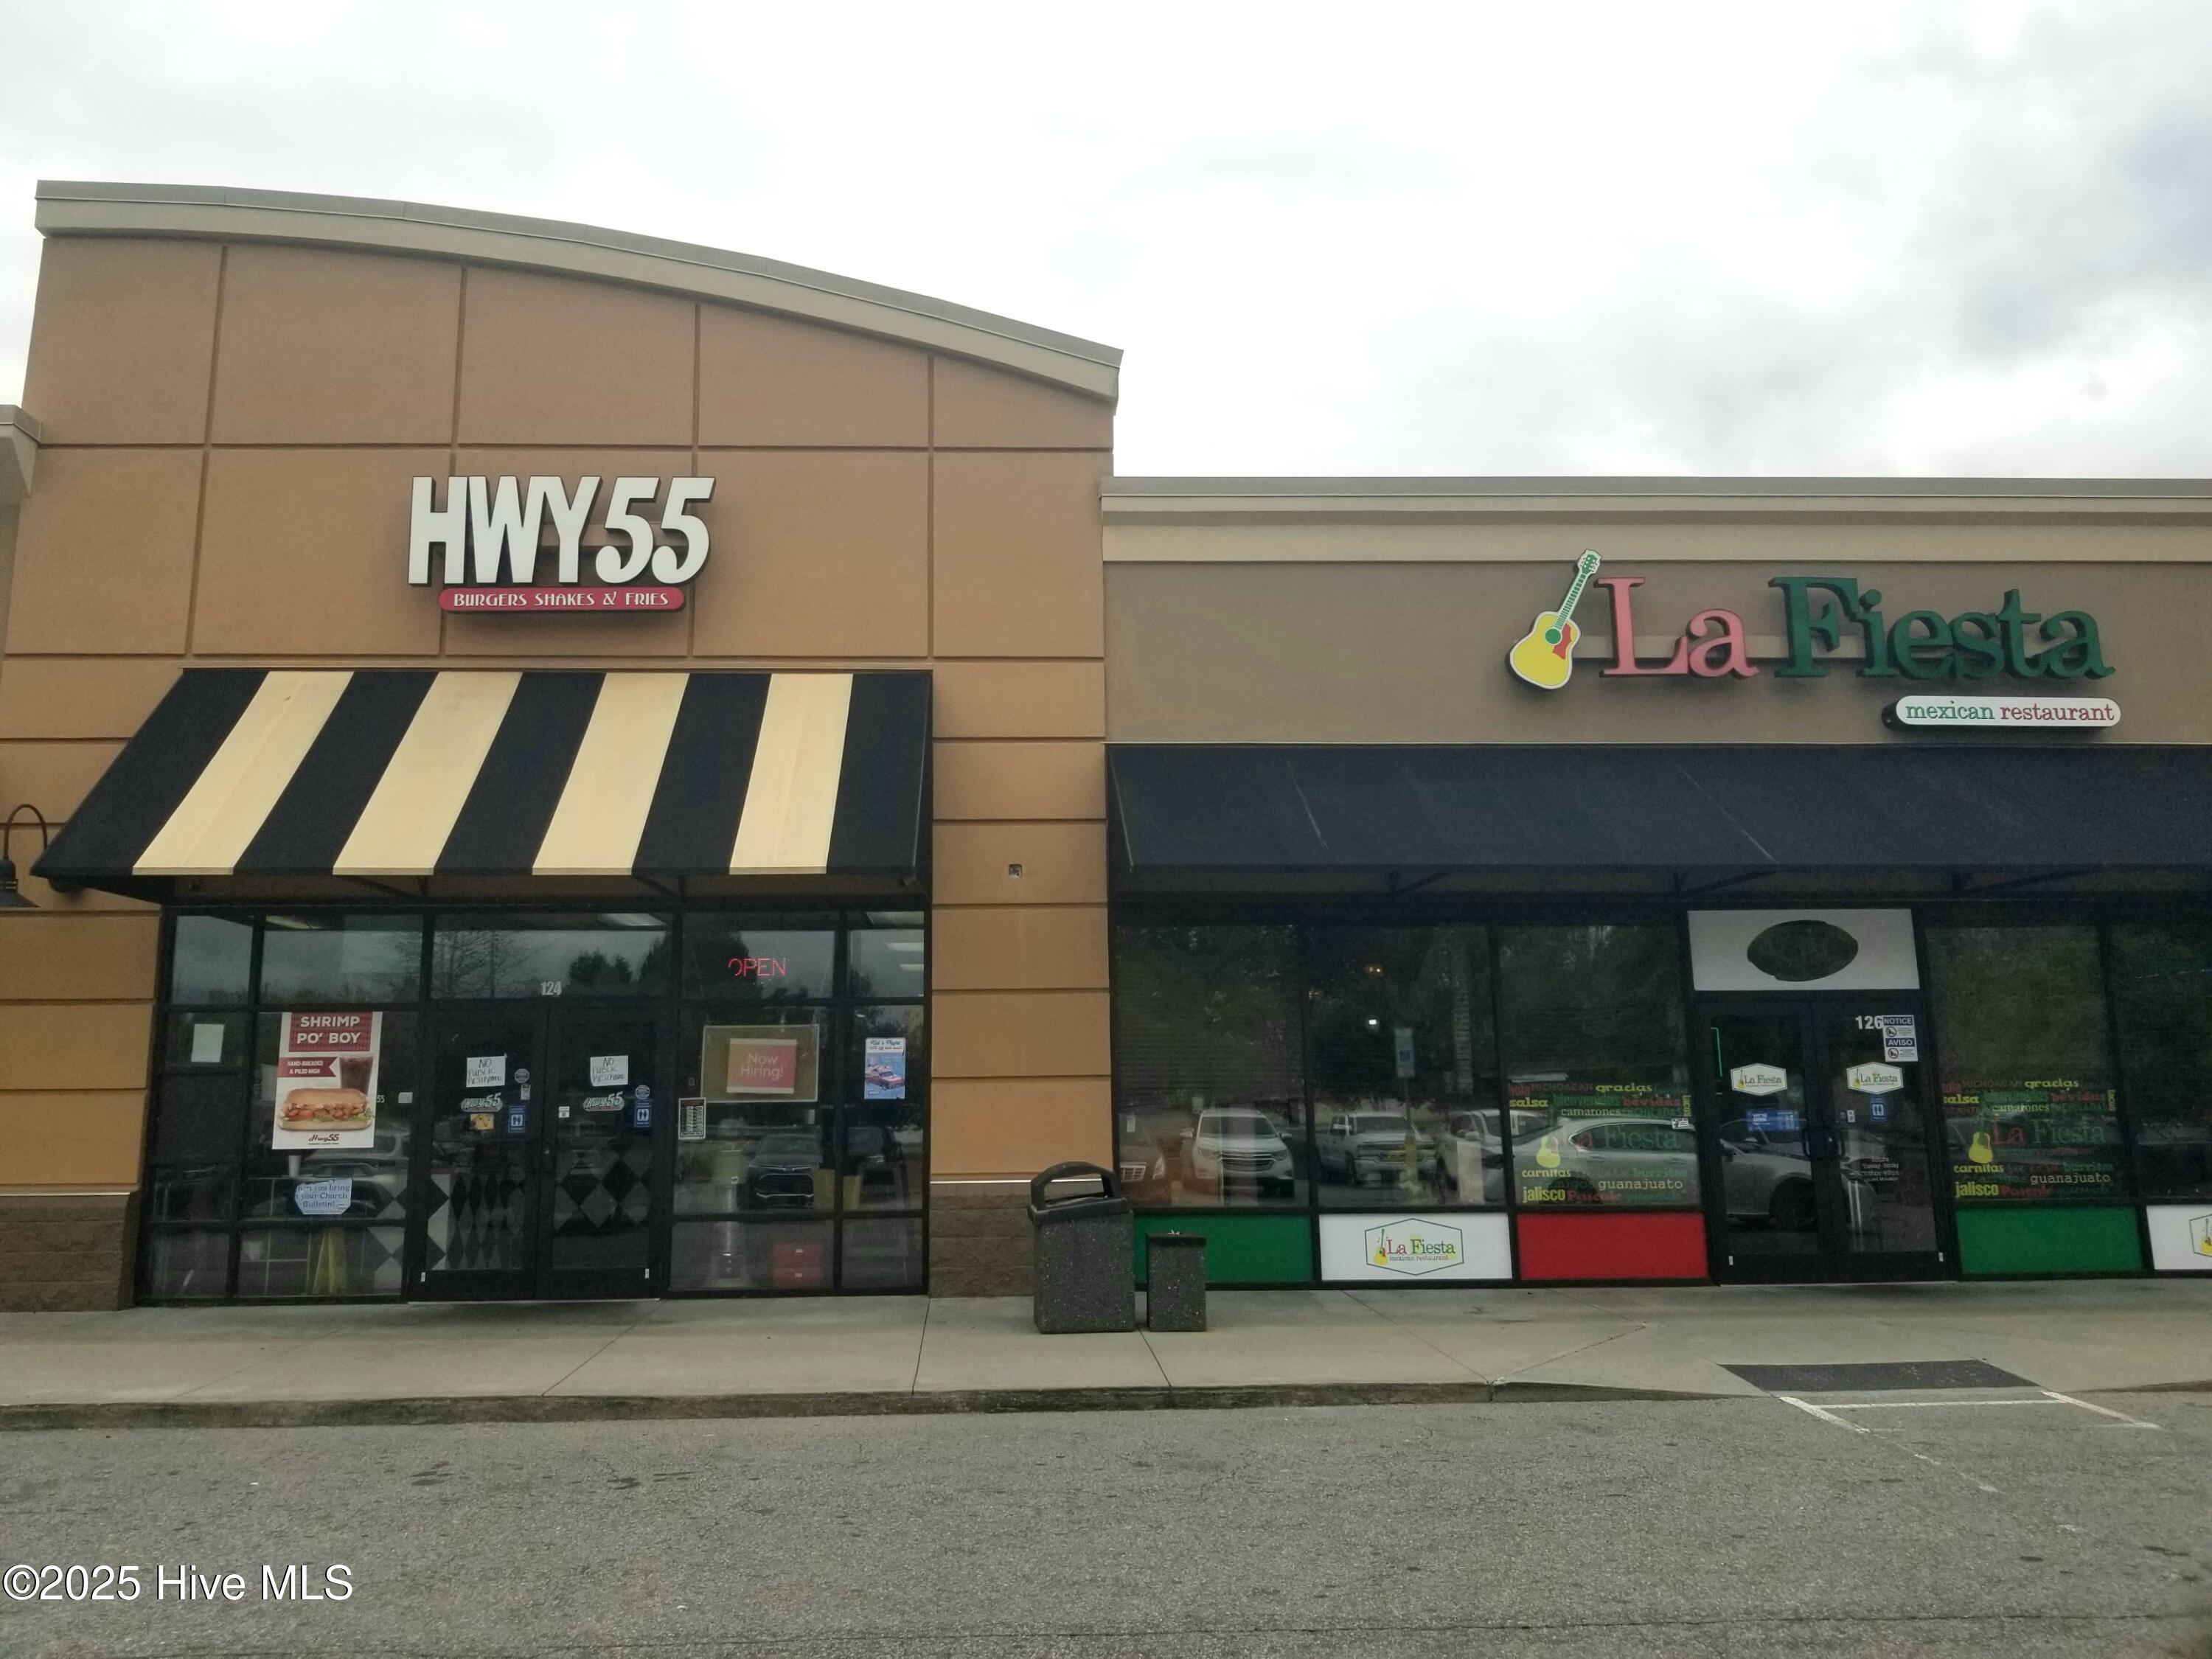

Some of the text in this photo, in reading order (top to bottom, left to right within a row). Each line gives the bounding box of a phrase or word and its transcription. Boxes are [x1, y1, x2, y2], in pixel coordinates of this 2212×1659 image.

[453, 591, 669, 607] BURGERS SHAKES & FRIES
[1594, 575, 2116, 681] La Fiesta
[1905, 699, 2115, 723] mexican restaurant
[728, 958, 787, 976] OPEN
[540, 981, 562, 995] 124
[300, 1016, 361, 1028] SHRIMP
[1855, 1015, 1883, 1030] 126
[296, 1032, 361, 1044] PO' BOY
[748, 1053, 779, 1063] Now
[740, 1065, 784, 1079] Hiring!
[1860, 1073, 1898, 1083] La Fiesta
[1745, 1074, 1782, 1084] La Fiesta
[2024, 1078, 2079, 1090] gracias
[1596, 1082, 1653, 1093] gracias
[1509, 1096, 1548, 1107] salsa
[1943, 1093, 1979, 1105] salsa
[1561, 1107, 1621, 1116] camarones
[1992, 1104, 2050, 1112] camarones
[2033, 1119, 2107, 1144] Fiesta
[1522, 1168, 1571, 1178] carnitas
[1954, 1164, 2004, 1174] carnitas
[1598, 1178, 1683, 1191] guanajuato
[2030, 1172, 2111, 1186] guanajuato
[330, 1183, 351, 1192] bring
[1955, 1181, 1999, 1198] jalisco
[1523, 1186, 1566, 1203] jalisco
[1385, 1238, 1456, 1254] La Fiesta
